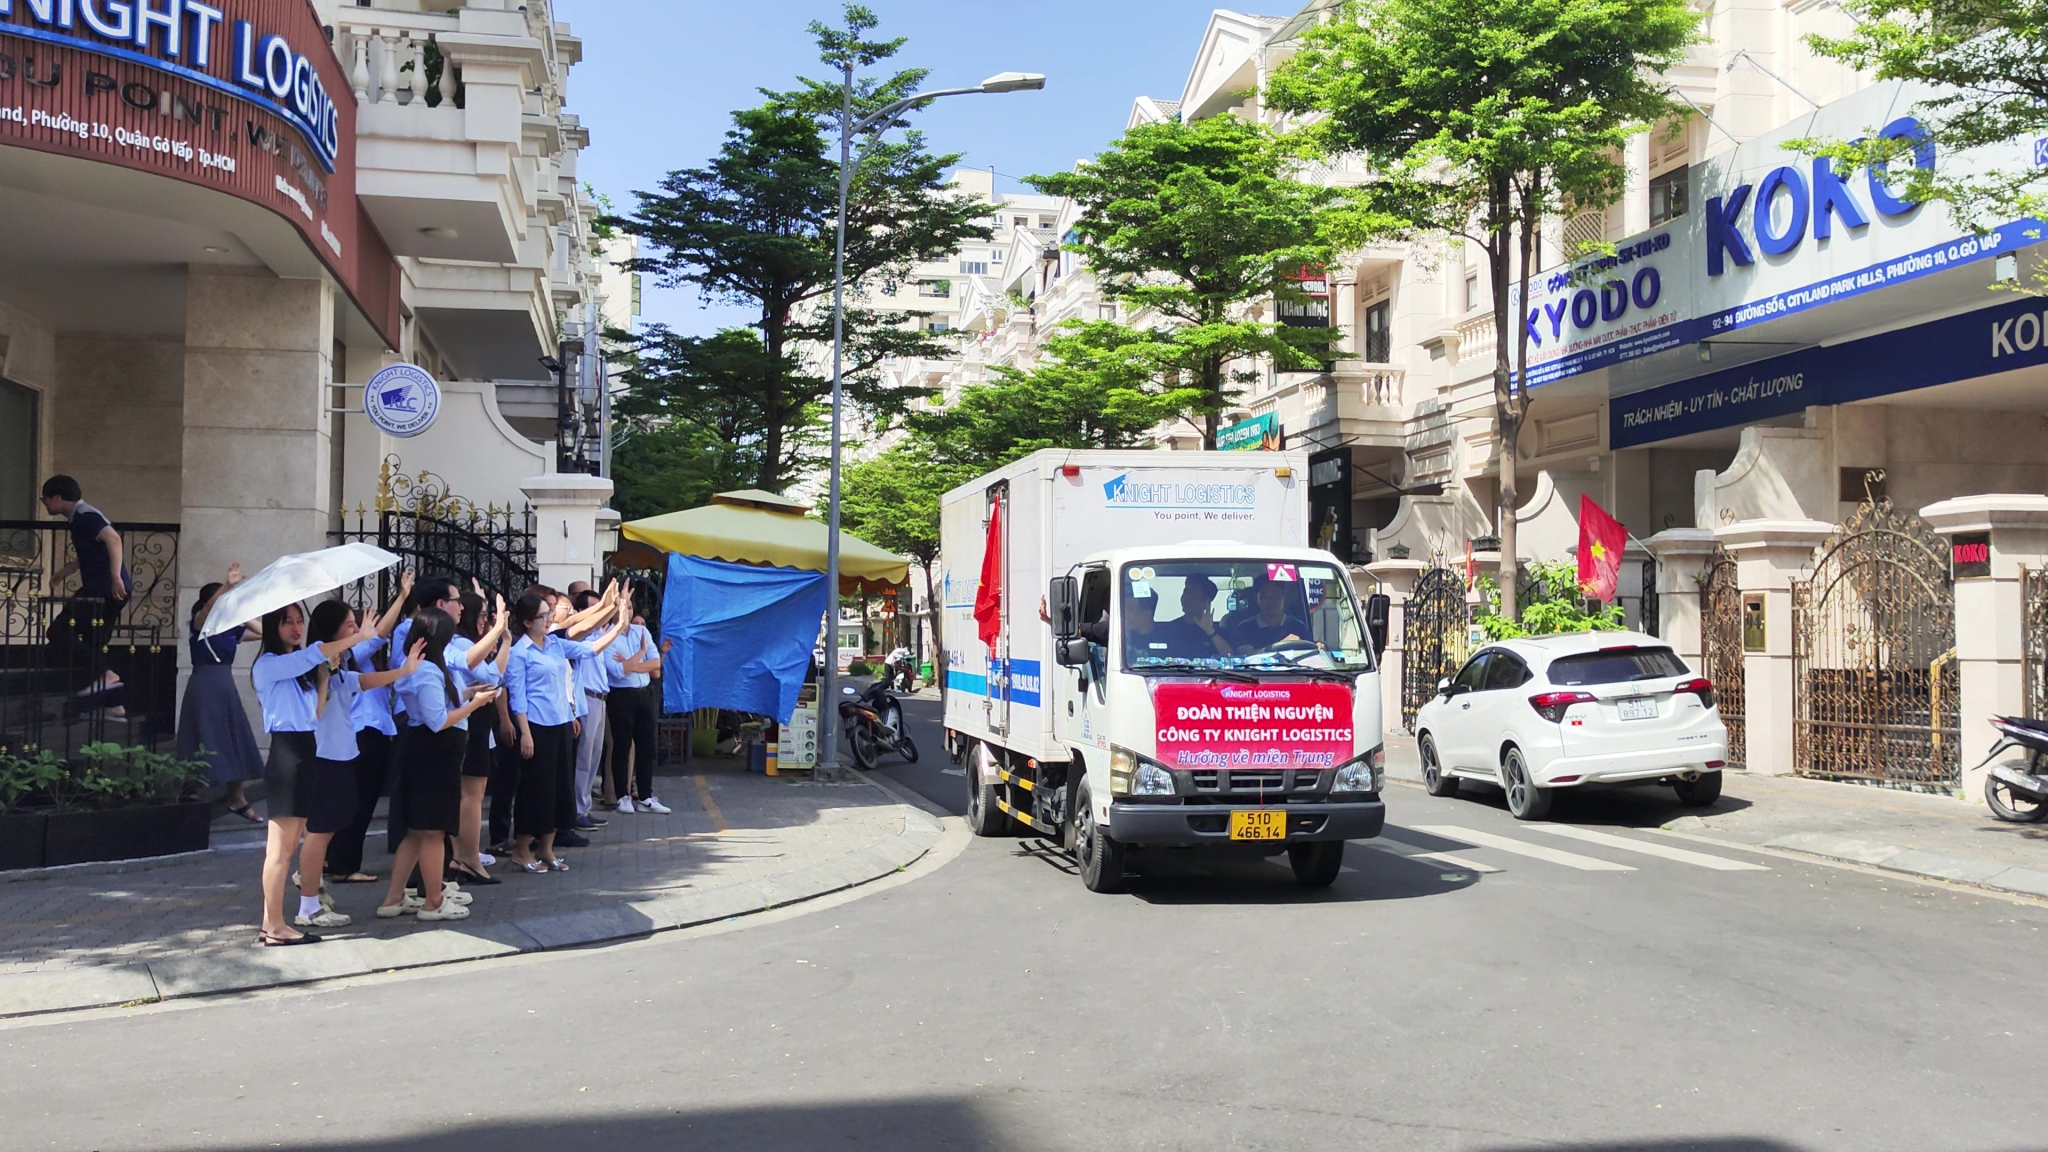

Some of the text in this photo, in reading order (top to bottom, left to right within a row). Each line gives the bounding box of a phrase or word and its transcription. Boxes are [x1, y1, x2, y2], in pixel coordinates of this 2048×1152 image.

[232, 19, 339, 160] LOGISTICS
[0, 106, 236, 173] nd, Phường 10, Quận Gò Vấp Tp.HCM
[246, 120, 288, 161] WE
[1707, 117, 1936, 276] KOKO
[1528, 279, 1543, 293] ODO
[1712, 311, 1733, 330] 92-94
[1735, 303, 1766, 324] ĐƯỜNG
[1765, 295, 1778, 314] SỐ
[1778, 299, 1787, 312] 6,
[1787, 286, 1830, 309] CITYLAND
[1830, 278, 1855, 297] PARK
[1856, 269, 1886, 289] HILLS,
[1886, 256, 1933, 279] PHƯỜNG
[1933, 250, 1948, 267] 10,
[1948, 237, 1979, 261] Q.GÒ
[1527, 267, 1661, 350] KYODO
[372, 368, 434, 397] KNIGHT LOGISTICS
[389, 393, 418, 411] KLC
[1623, 409, 1652, 428] TRÁCH
[1653, 399, 1682, 422] NHIỆM
[1690, 397, 1705, 414] UY
[1706, 389, 1723, 409] TÍN
[1731, 377, 1758, 404] CHẤT
[1760, 372, 1804, 398] LƯỢNG
[370, 404, 380, 417] YOU
[407, 411, 430, 430] DELIVER
[1112, 483, 1256, 504] KNIGHT LOGISTICS
[1153, 511, 1255, 522] You point, We deliver.
[1954, 543, 1988, 563] KOKO
[1746, 611, 1762, 630] 94
[1225, 690, 1291, 698] KNIGHT LOGISTICS
[1177, 703, 1334, 722] ĐOÀN THIỆN NGUYỆN
[1623, 707, 1654, 718] 897.12
[1628, 701, 1645, 709] 51L
[1158, 726, 1352, 742] CÔNG TY KNIGHT LOGISTICS
[1178, 748, 1334, 767] Hướng về miền Trung
[1247, 813, 1271, 825] 51D
[1237, 826, 1280, 838] 466.14
